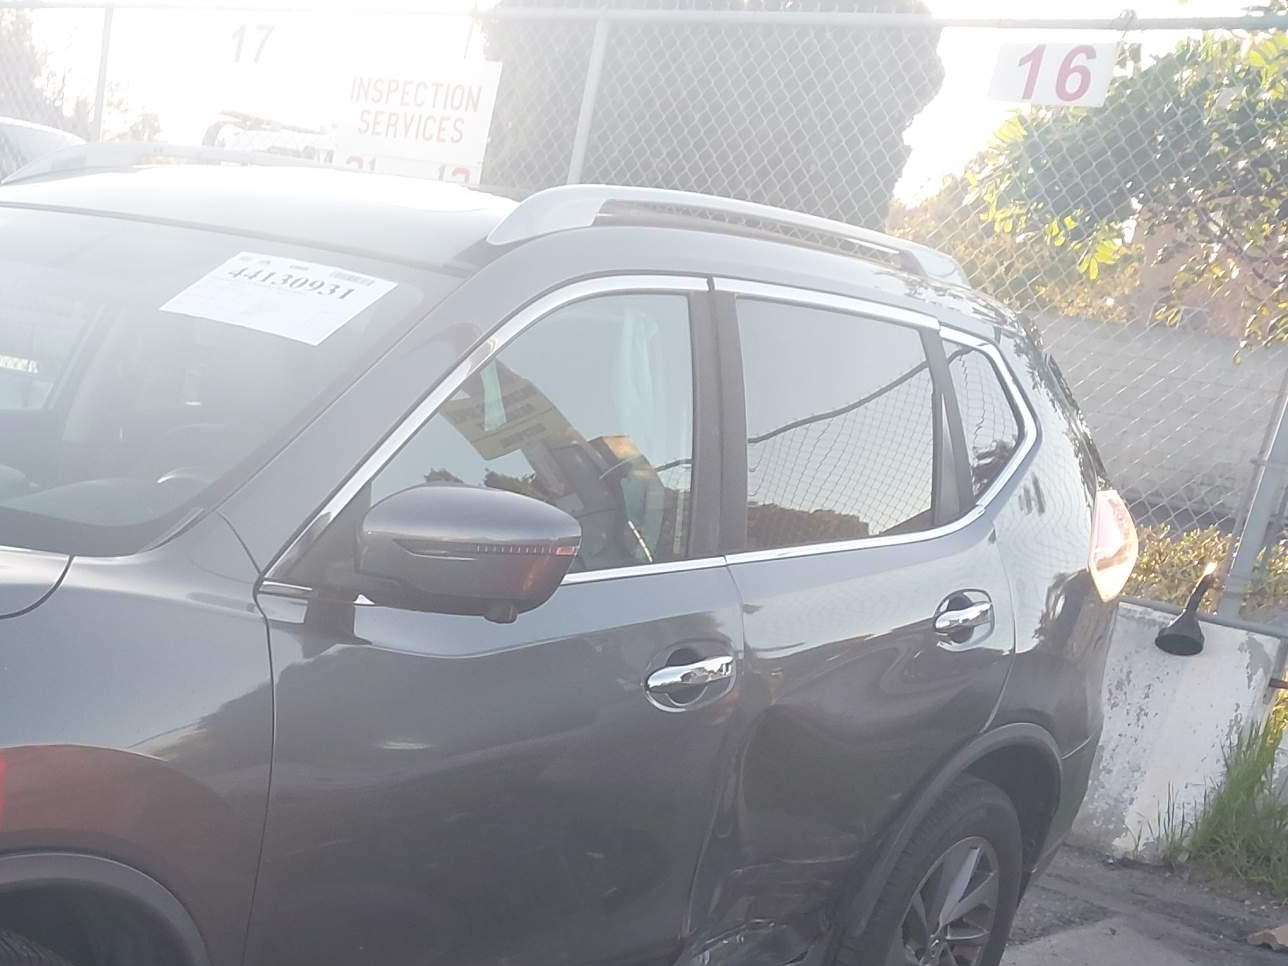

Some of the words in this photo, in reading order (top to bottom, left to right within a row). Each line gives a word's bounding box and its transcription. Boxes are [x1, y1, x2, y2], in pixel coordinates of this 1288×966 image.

[230, 23, 276, 65] 17
[1017, 43, 1097, 102] 16
[349, 75, 483, 113] INSPECTION
[357, 109, 466, 144] SERVICES
[228, 266, 355, 300] 44130931
